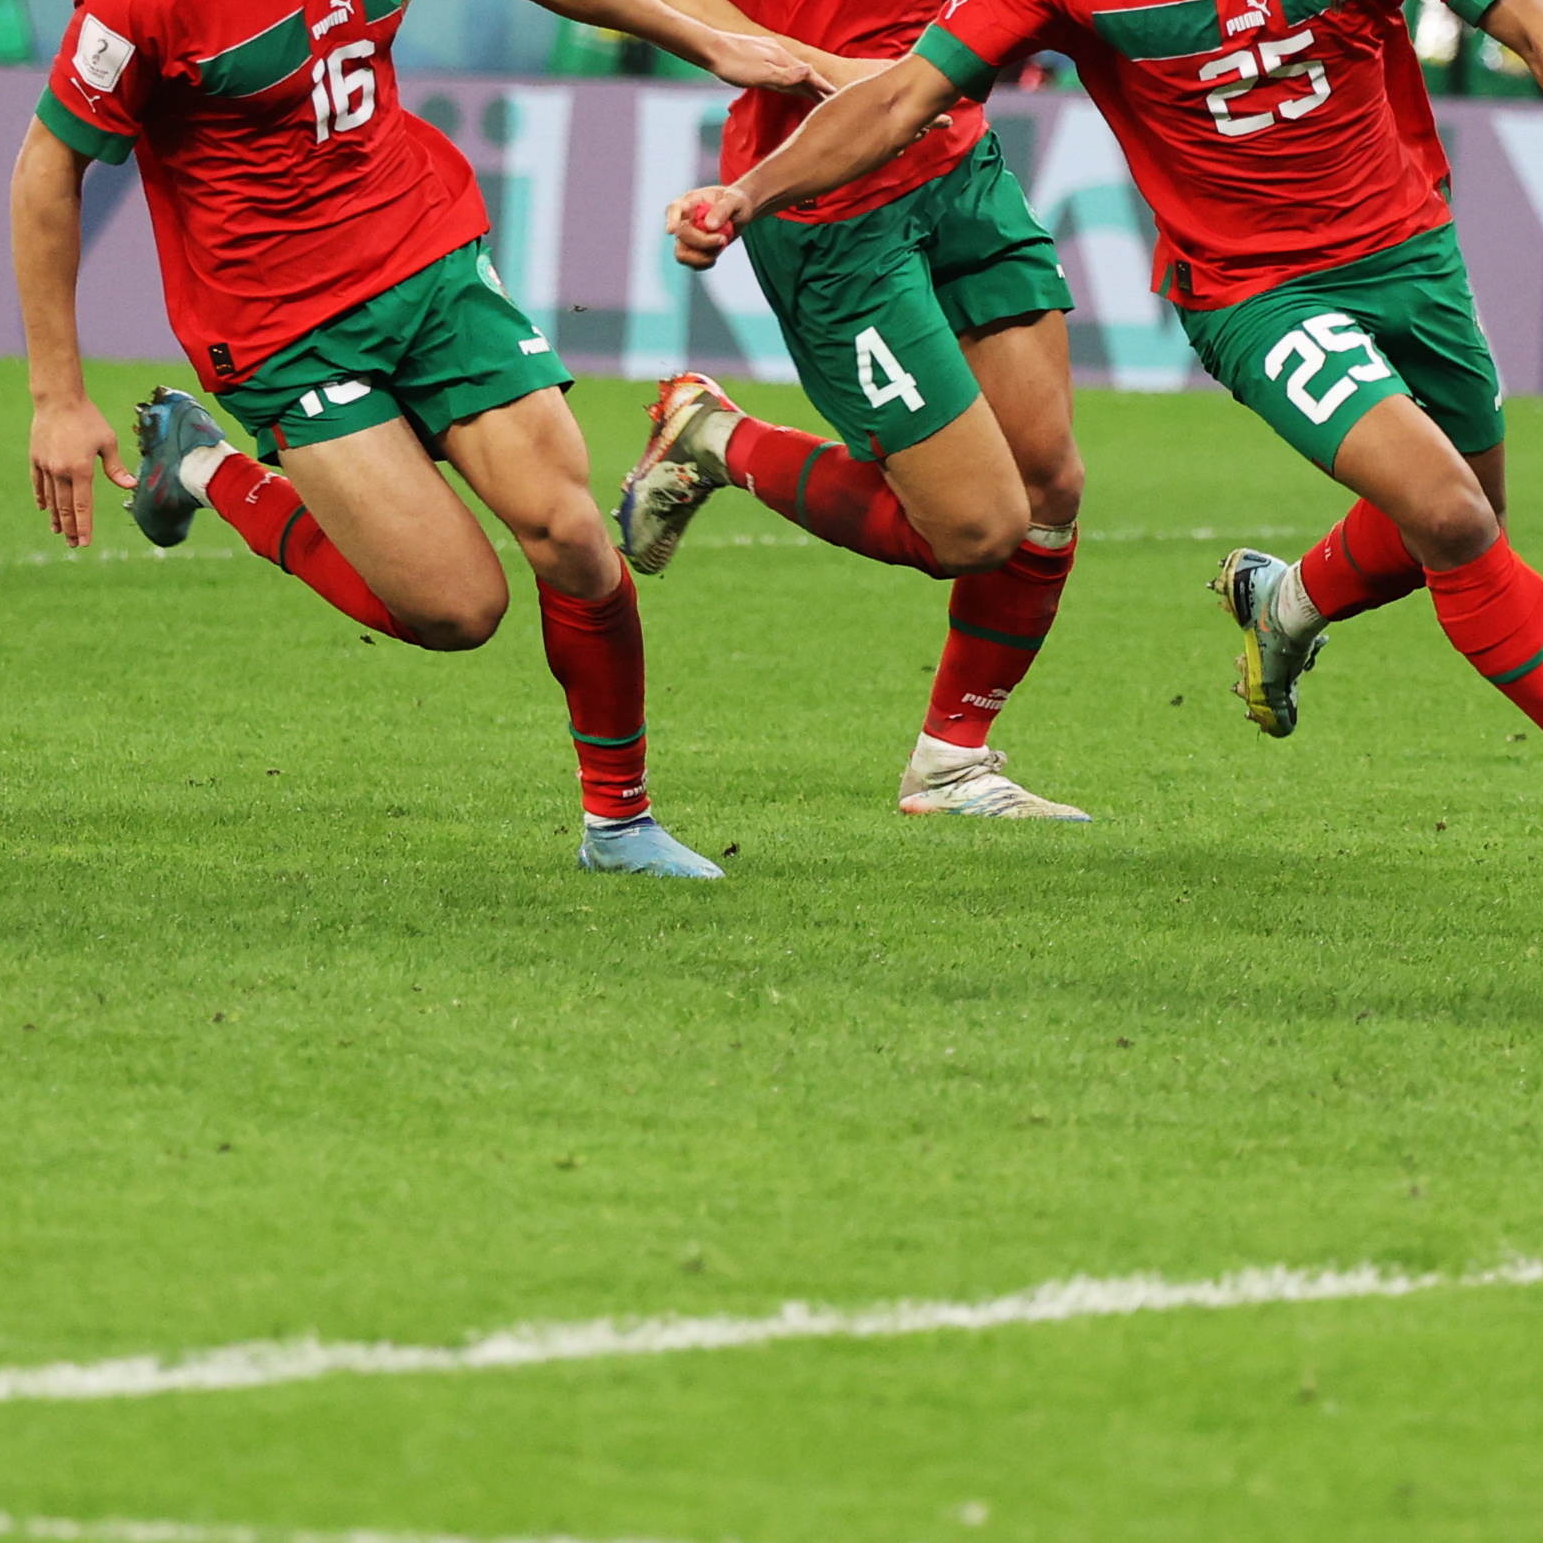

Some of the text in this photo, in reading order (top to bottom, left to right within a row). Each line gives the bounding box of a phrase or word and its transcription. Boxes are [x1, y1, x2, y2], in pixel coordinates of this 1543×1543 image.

[311, 8, 349, 40] PUMA
[1226, 10, 1265, 36] PUMA
[311, 39, 376, 145] 16
[1198, 29, 1332, 137] 25
[855, 326, 926, 413] 4
[1264, 313, 1392, 425] 25
